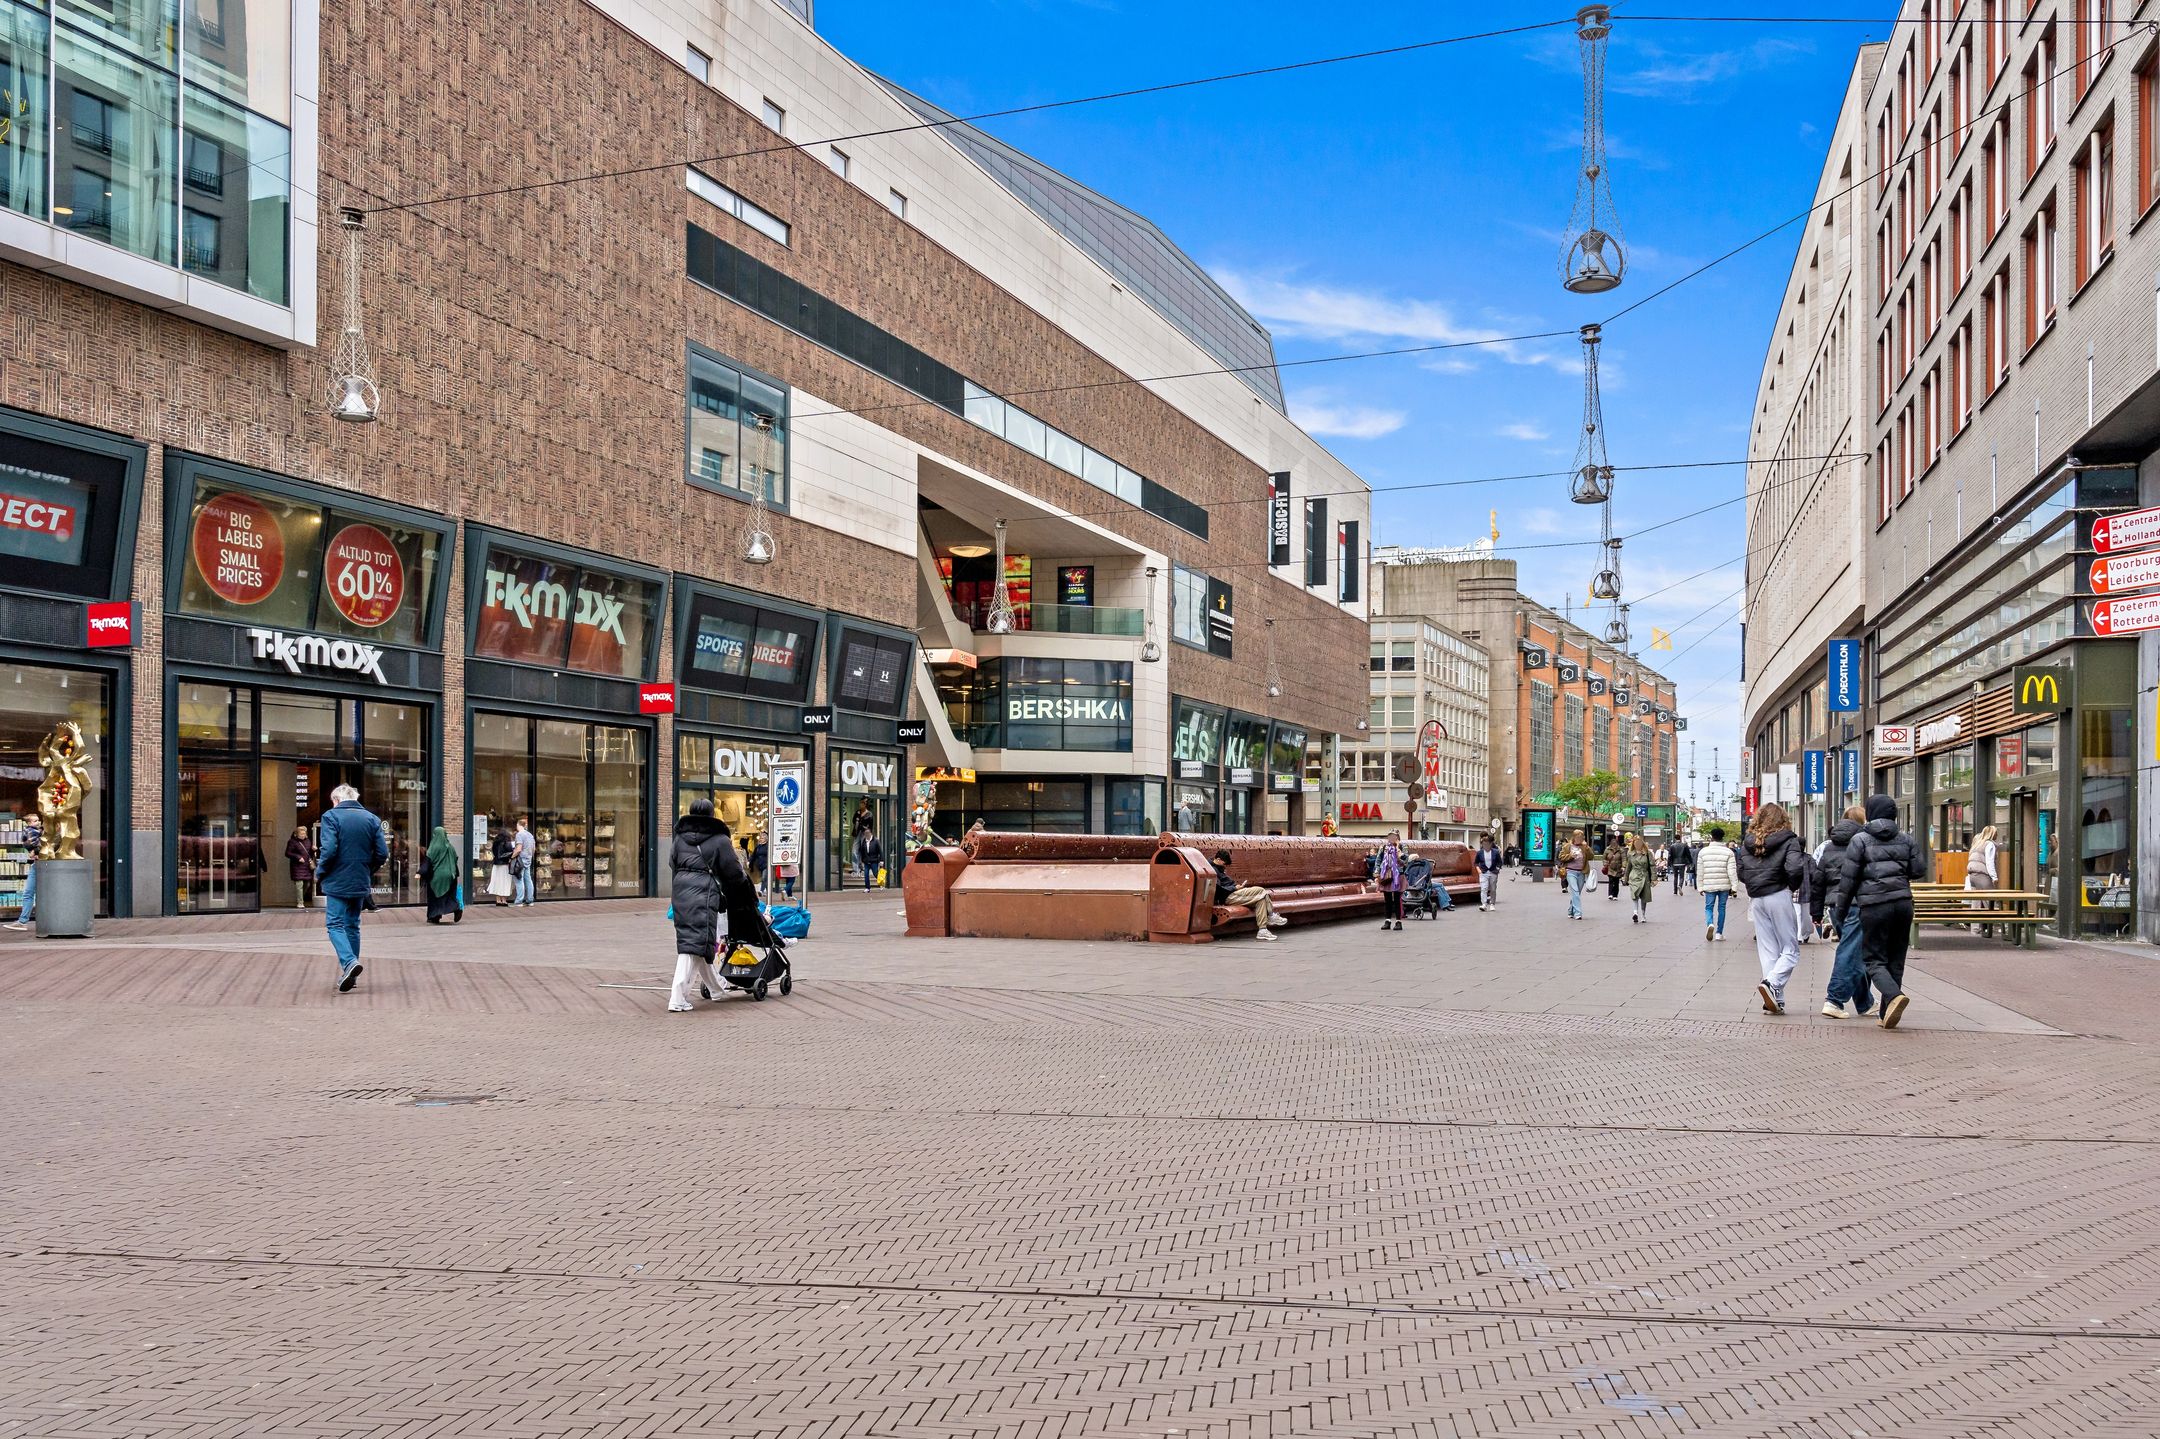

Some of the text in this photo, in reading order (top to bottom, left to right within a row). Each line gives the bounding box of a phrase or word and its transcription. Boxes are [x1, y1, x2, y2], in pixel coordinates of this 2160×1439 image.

[0, 497, 67, 531] ECT
[230, 511, 252, 530] BIG
[217, 526, 263, 549] LABELS
[220, 549, 260, 570] SMALL
[338, 545, 392, 567] ALTIJD TOT
[2109, 556, 2160, 571] Voorburg
[217, 566, 262, 587] PRICES
[337, 561, 392, 600] 60%
[2110, 571, 2159, 585] Leidsche
[2113, 600, 2160, 613] Zoeterm
[696, 634, 743, 658] SPORTS
[1840, 644, 1848, 694] DECATHLON
[804, 714, 831, 725] ONLY
[1009, 698, 1126, 720] BERSHKA
[899, 728, 924, 736] ONLY
[1426, 724, 1440, 795] HEMA
[841, 759, 895, 788] ONLY
[1341, 801, 1382, 818] EMA
